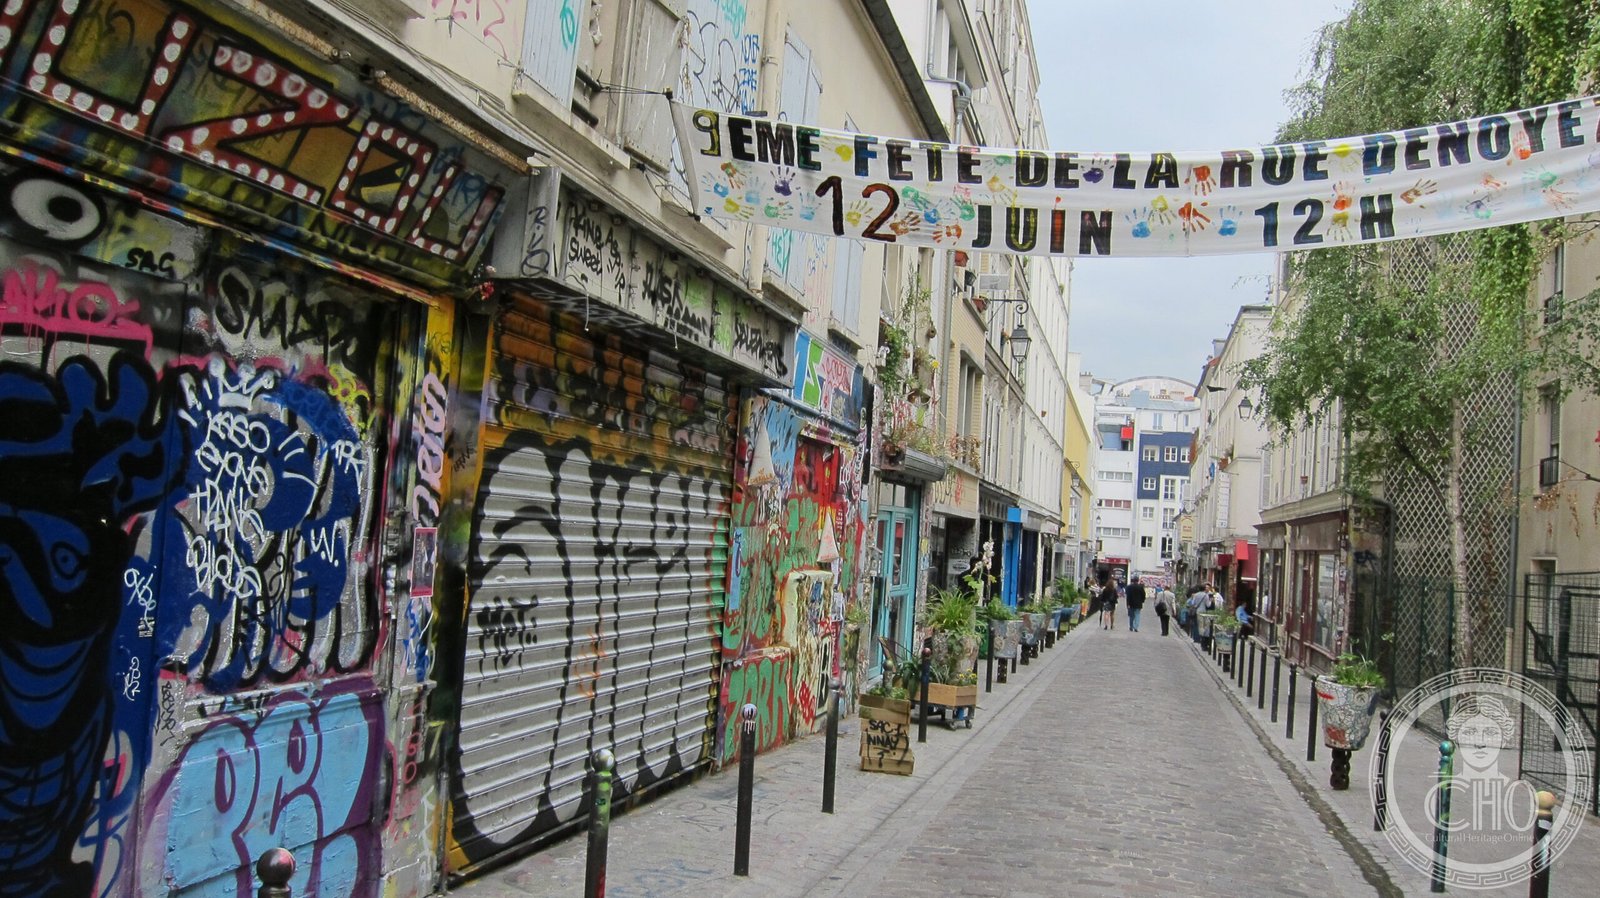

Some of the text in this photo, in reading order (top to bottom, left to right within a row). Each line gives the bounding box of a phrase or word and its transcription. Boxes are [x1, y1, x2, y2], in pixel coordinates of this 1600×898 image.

[854, 135, 983, 184] FETE
[1015, 150, 1079, 189] DE
[1113, 152, 1179, 189] LA
[1220, 142, 1329, 188] RUE
[1361, 99, 1600, 176] DENOYE
[815, 175, 1395, 256] 12 JUIN 12 H
